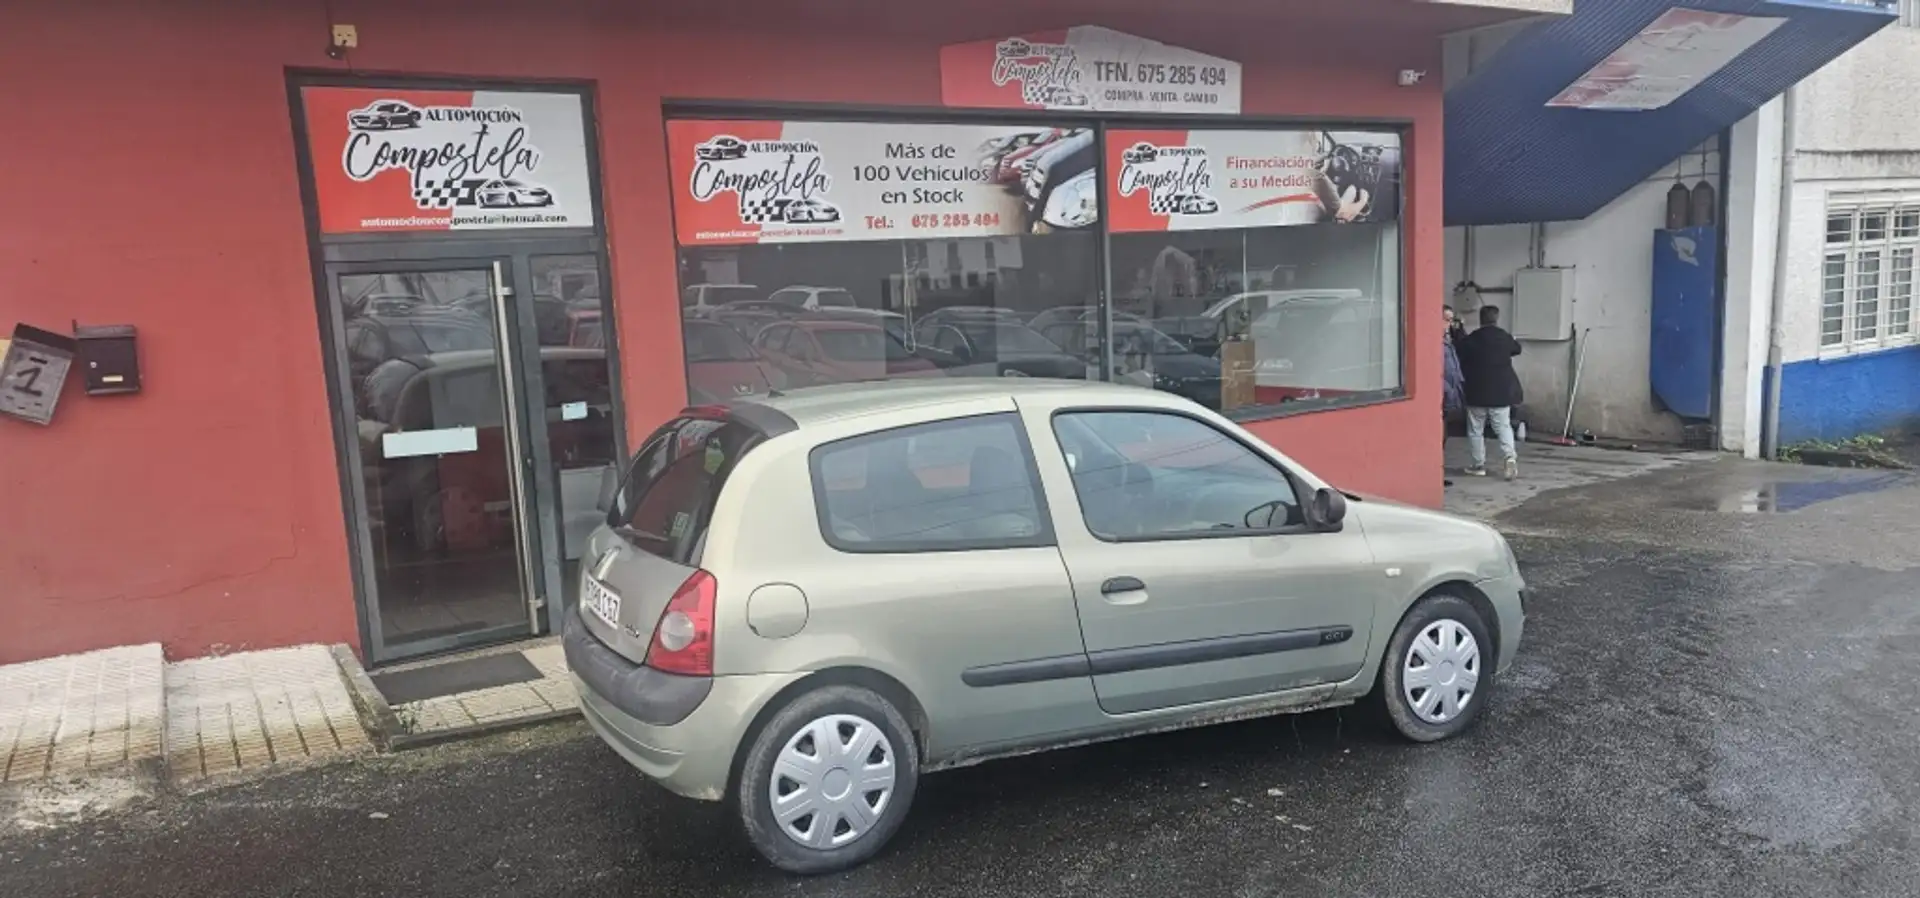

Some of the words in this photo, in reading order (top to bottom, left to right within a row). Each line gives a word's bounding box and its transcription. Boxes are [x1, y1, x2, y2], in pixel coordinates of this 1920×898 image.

[1093, 61, 1133, 82] TFN.
[1137, 63, 1165, 84] 675
[1169, 65, 1196, 85] 285
[1200, 66, 1226, 86] 494
[1104, 89, 1144, 102] COMPRA
[1149, 91, 1178, 103] VENTA
[1182, 92, 1218, 105] CAMBIO
[425, 107, 521, 123] AUTOMOCIÓN
[346, 123, 540, 190] Compostela
[885, 142, 926, 159] Más
[931, 143, 956, 159] de
[1226, 155, 1314, 169] Financiación
[692, 153, 829, 208] Compostela
[853, 164, 891, 181] 100
[1119, 157, 1211, 202] Compostela
[1229, 178, 1239, 189] a
[1241, 178, 1258, 189] su
[1261, 174, 1312, 188] Medida
[881, 190, 907, 204] en
[912, 187, 964, 204] Stock
[864, 214, 894, 230] Tel.:
